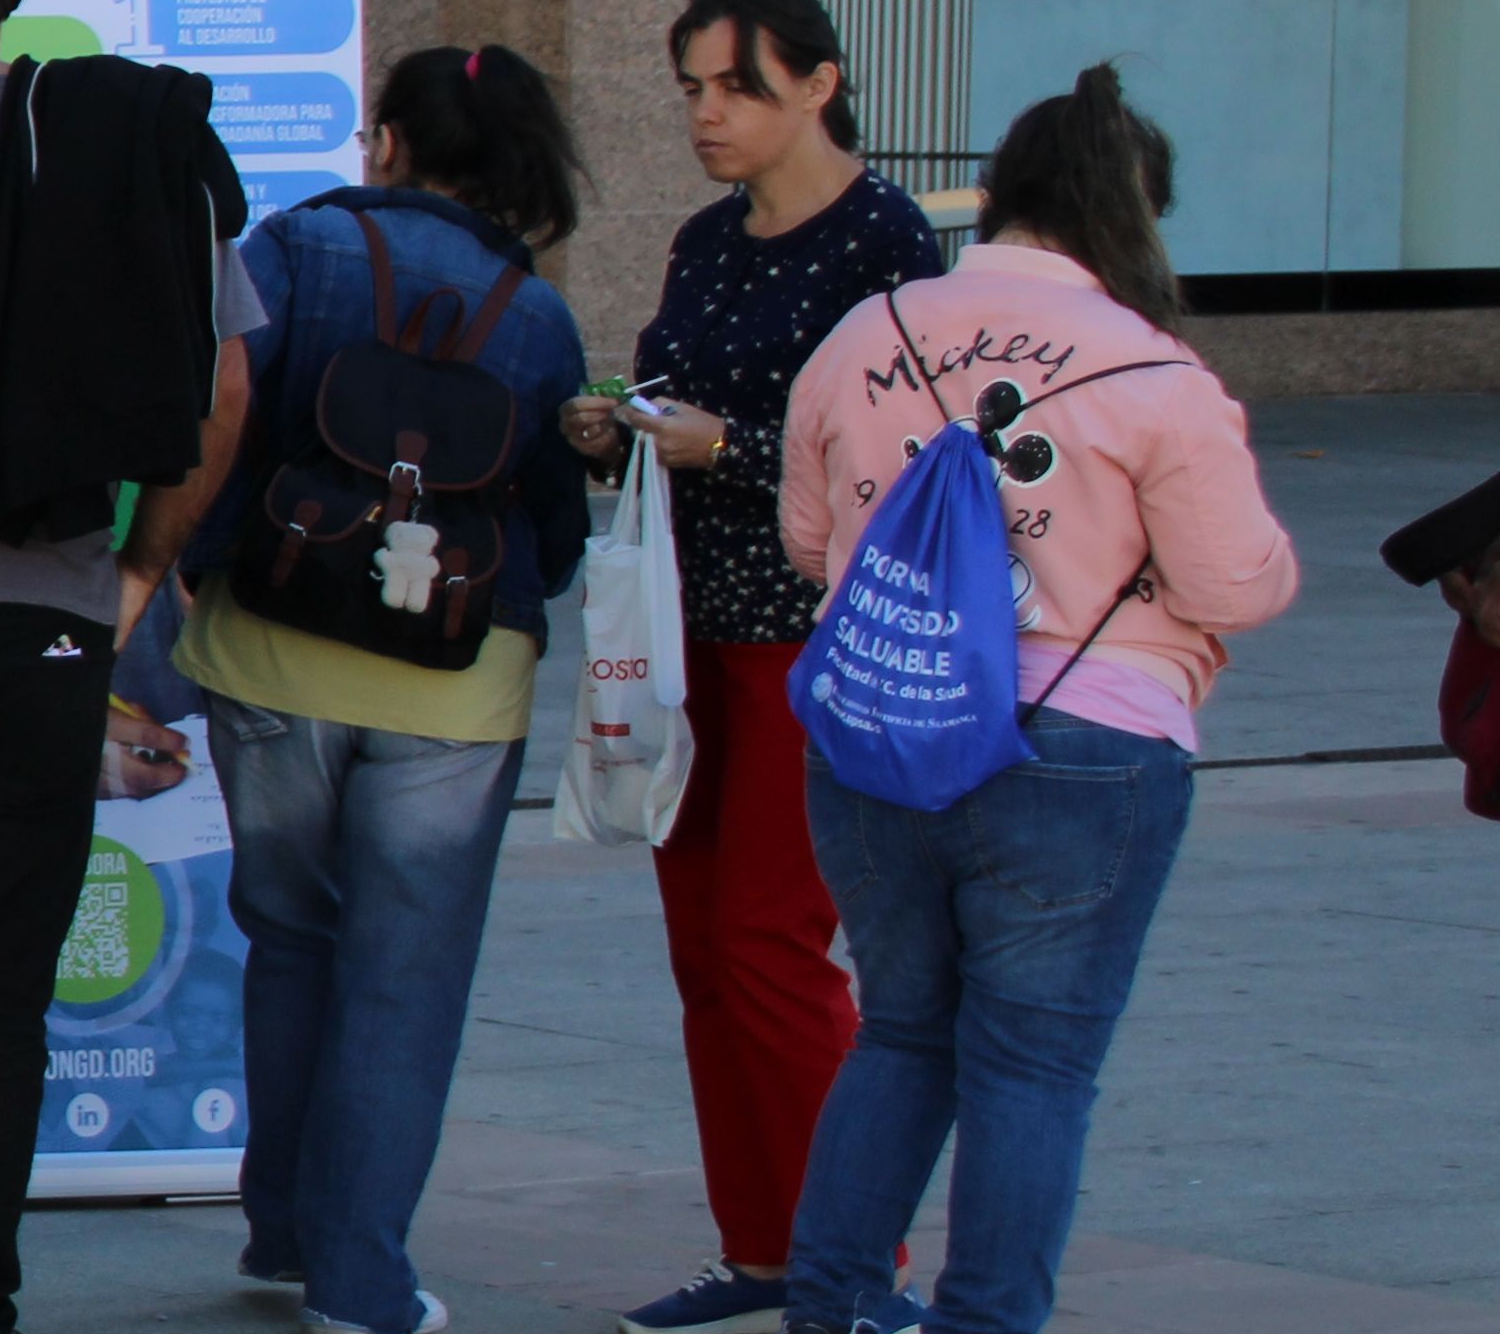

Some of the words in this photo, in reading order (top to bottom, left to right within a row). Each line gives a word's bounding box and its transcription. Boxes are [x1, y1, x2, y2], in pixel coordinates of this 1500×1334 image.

[176, 5, 262, 25] COOPERACIÓN
[177, 29, 193, 45] AL
[196, 27, 275, 45] DESARROLLO
[864, 328, 1075, 407] Mickey
[1010, 509, 1051, 538] 28
